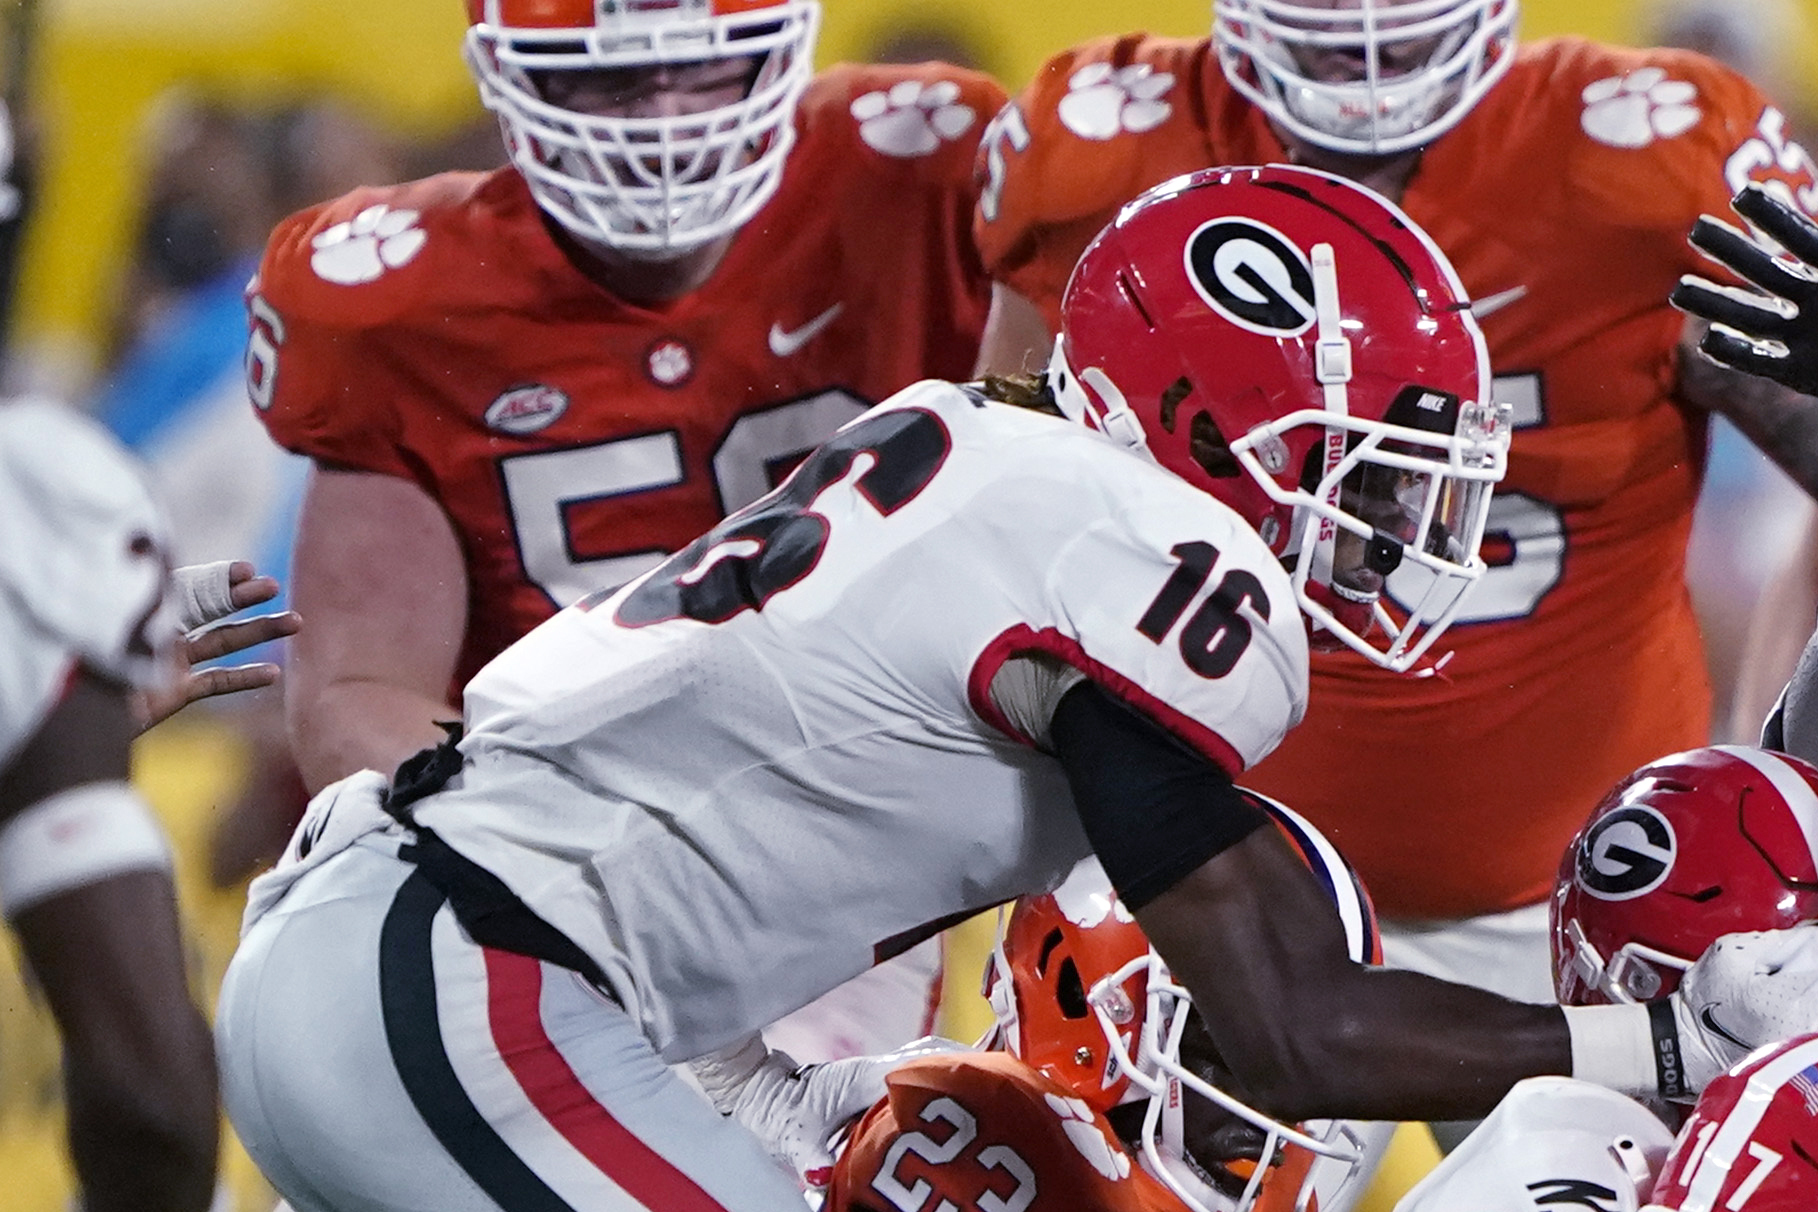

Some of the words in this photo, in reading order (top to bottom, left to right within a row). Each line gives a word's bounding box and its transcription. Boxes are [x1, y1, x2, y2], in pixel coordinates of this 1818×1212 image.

[1417, 393, 1448, 413] NIKE
[1134, 540, 1272, 680] 16
[1577, 805, 1675, 898] G
